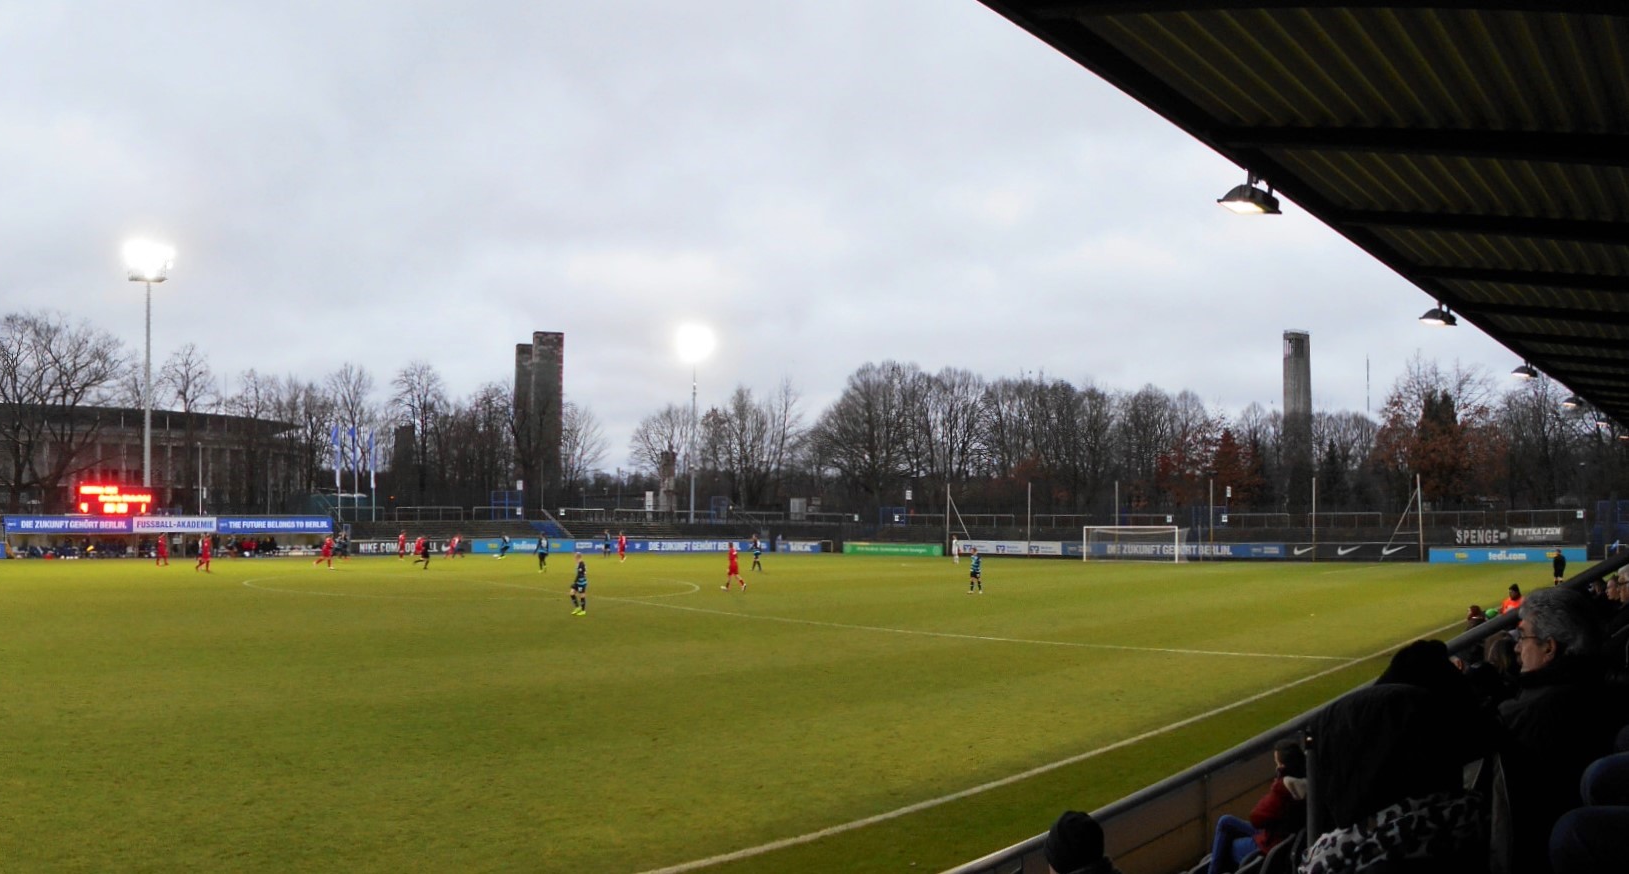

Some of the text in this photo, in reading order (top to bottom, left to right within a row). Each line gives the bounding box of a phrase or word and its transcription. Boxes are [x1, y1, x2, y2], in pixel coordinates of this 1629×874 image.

[21, 520, 33, 529] DIE
[35, 520, 69, 529] ZUKUNFT
[70, 519, 98, 529] GEHÖRT
[137, 521, 213, 529] FUSSBALL-AKADEMIE
[230, 521, 242, 529] THE
[242, 521, 266, 529] FUTURE
[267, 521, 295, 529] BELONGS
[1513, 527, 1561, 536] FETTKATZEN
[1456, 529, 1499, 544] SPENGE
[1122, 544, 1161, 555] ZUKUNFT
